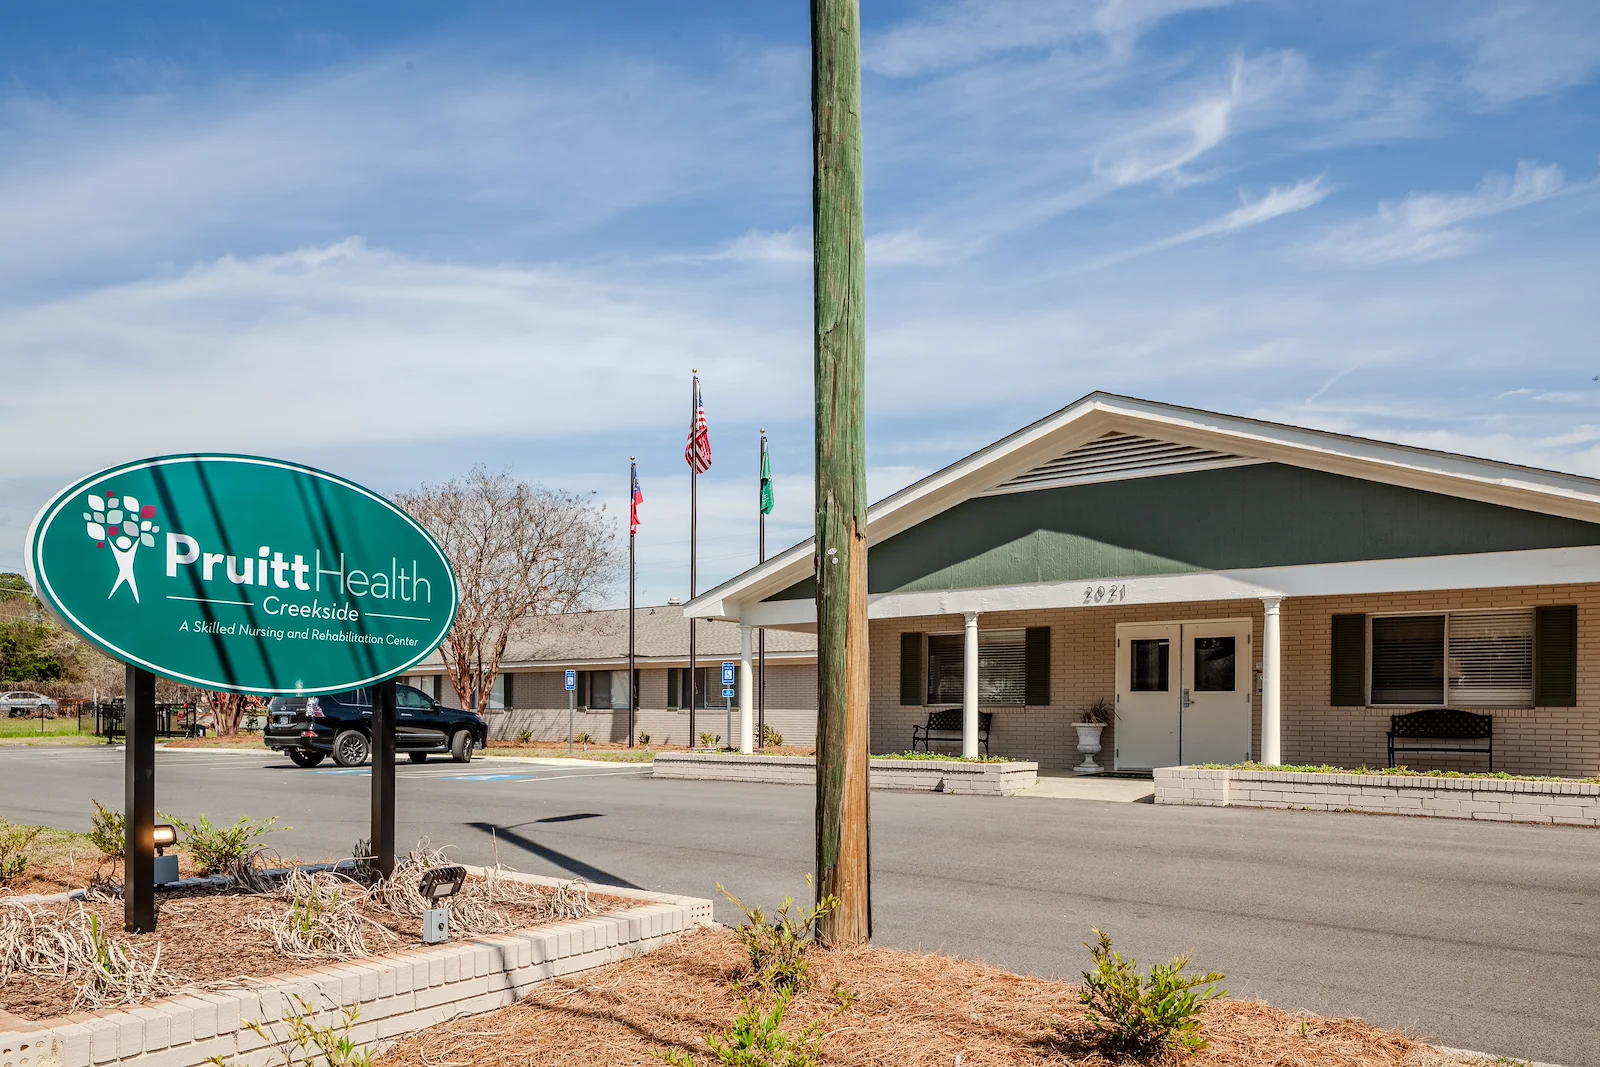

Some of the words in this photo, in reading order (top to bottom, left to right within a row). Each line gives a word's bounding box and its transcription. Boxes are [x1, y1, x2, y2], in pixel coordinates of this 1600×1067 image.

[1083, 584, 1126, 603] 2021
[263, 595, 359, 622] Creekside
[178, 620, 190, 632] A
[193, 620, 236, 635] Skilled
[239, 624, 284, 641] Nursing
[287, 628, 310, 640] and
[311, 629, 384, 645] Rehabilitation
[386, 634, 419, 646] Center
